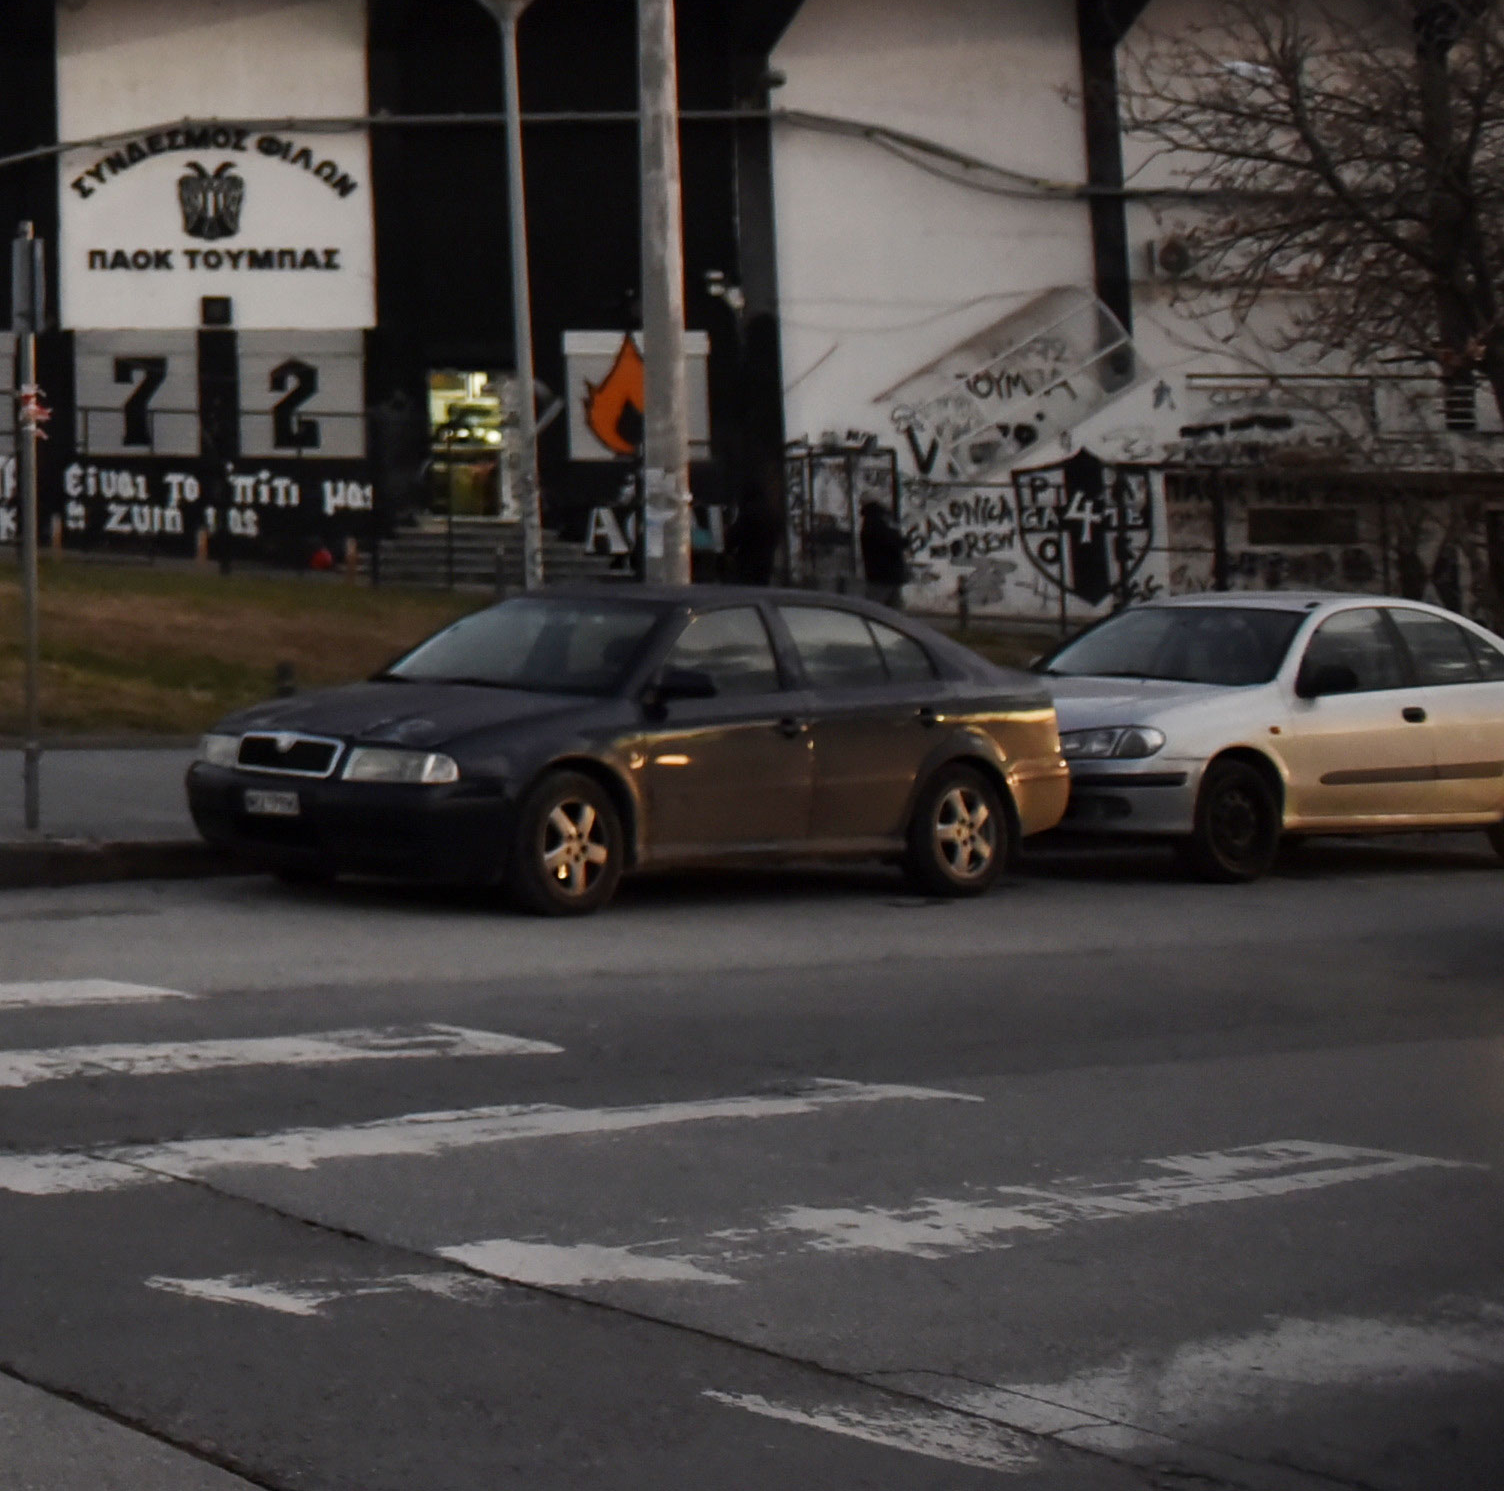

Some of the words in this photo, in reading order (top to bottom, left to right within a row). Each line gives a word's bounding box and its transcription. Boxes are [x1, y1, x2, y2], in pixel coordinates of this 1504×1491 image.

[70, 127, 250, 199] ΣΥΝΔΕΣΜΟΣ
[256, 135, 358, 199] ΦΙΛΩΝ
[87, 249, 174, 270] ΠΑΟΚ
[182, 249, 341, 271] ΤΟΥΜΠΑΣ
